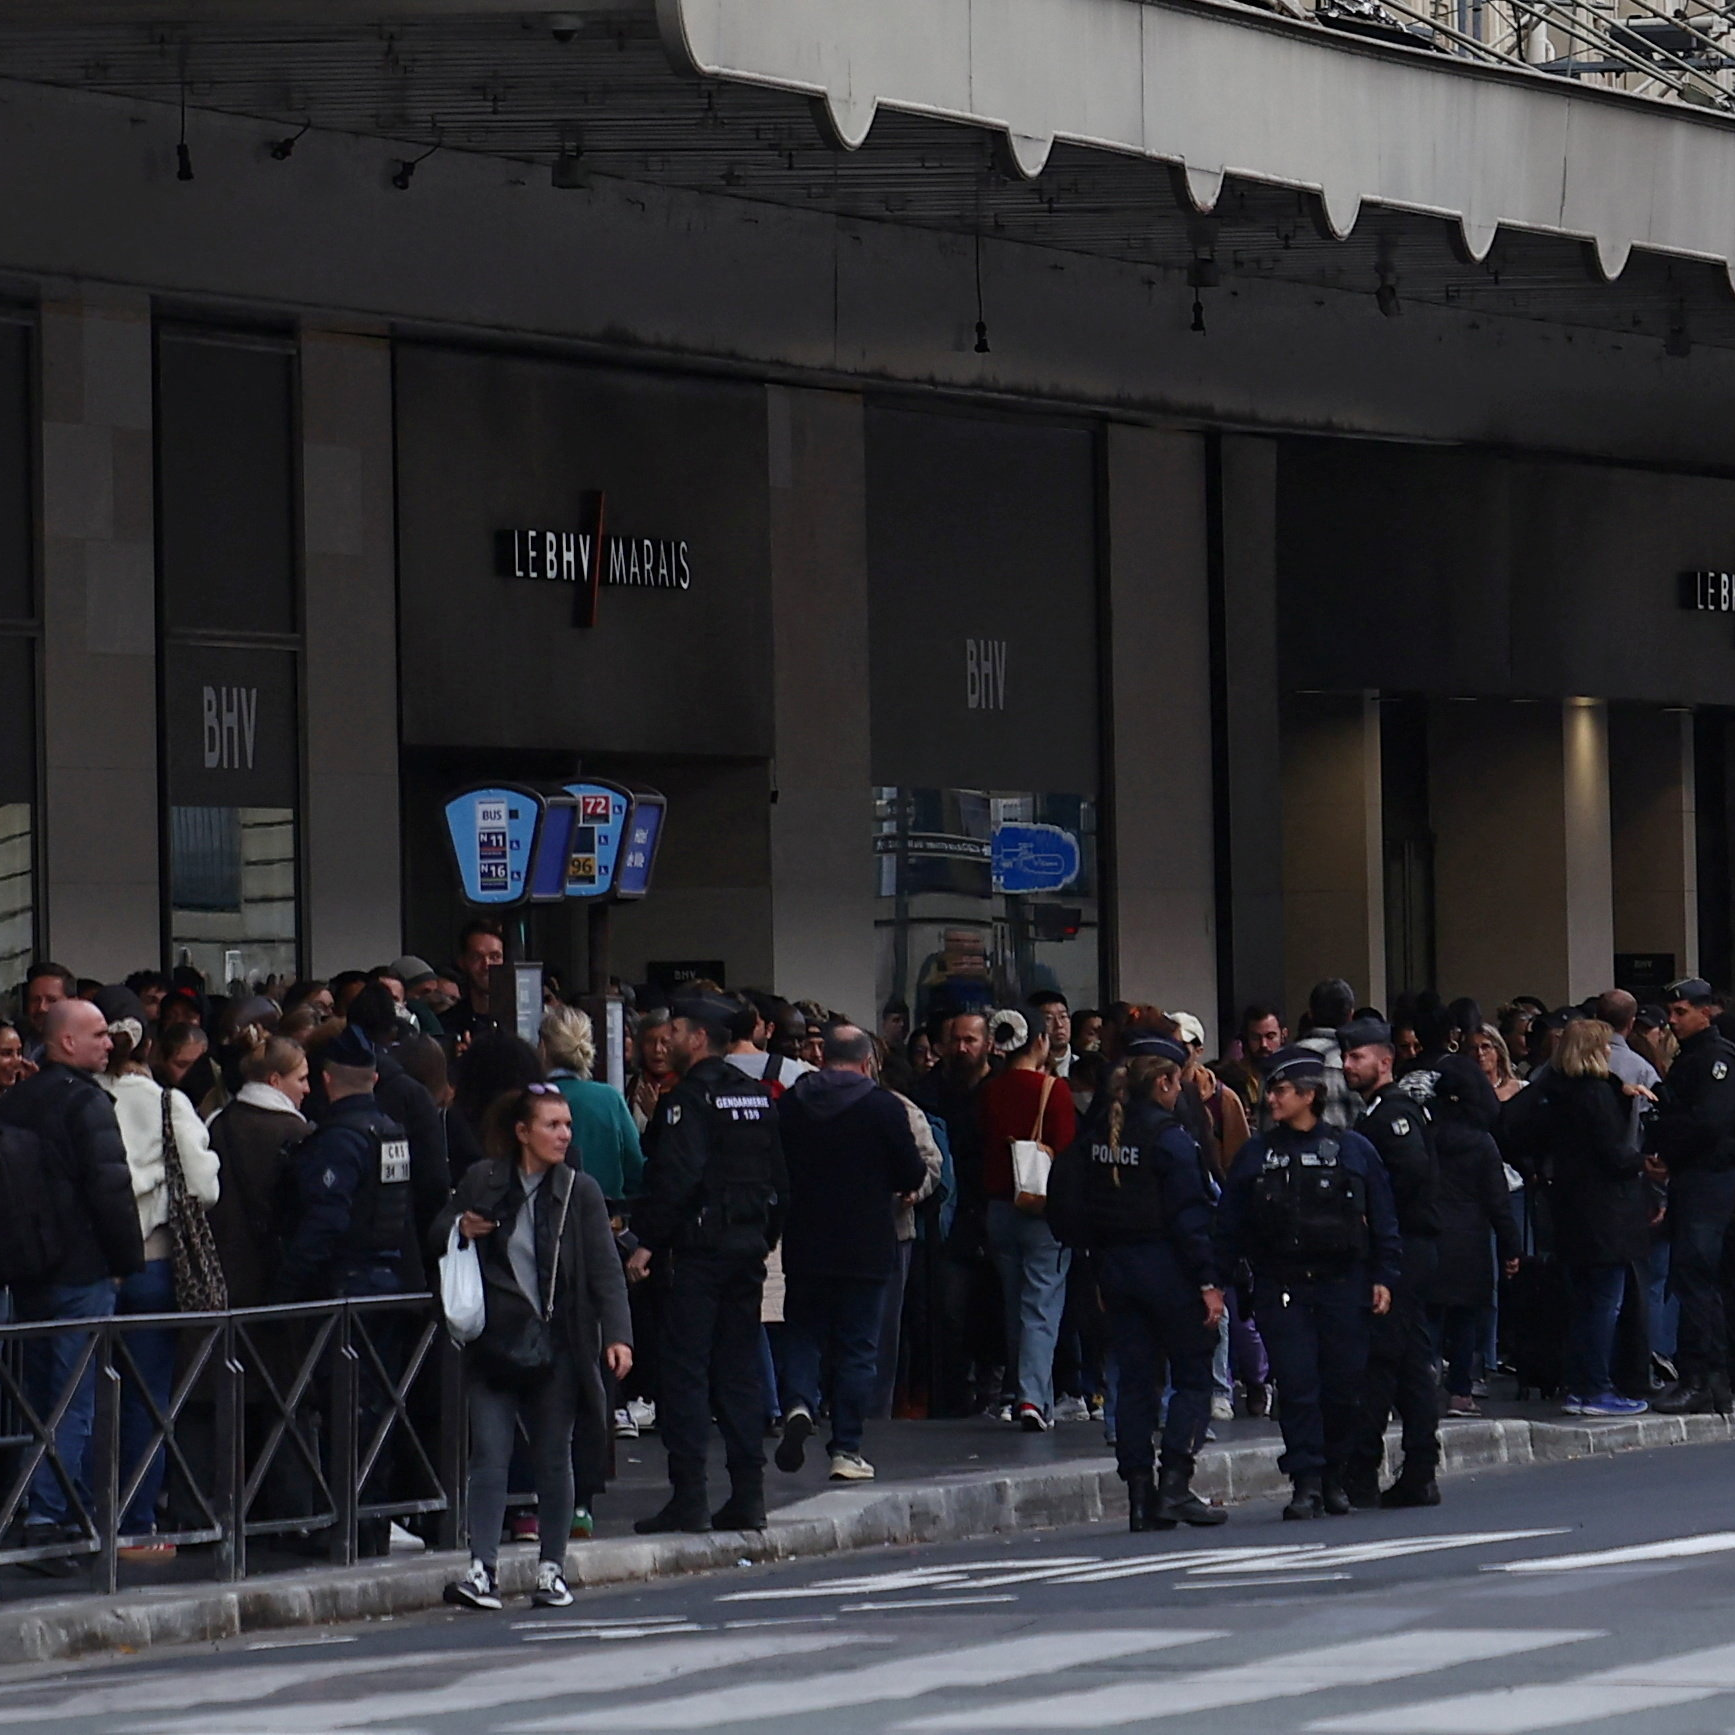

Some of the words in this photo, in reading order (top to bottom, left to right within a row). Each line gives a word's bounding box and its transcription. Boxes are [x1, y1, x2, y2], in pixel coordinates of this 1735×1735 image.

[514, 529, 538, 578] LE
[545, 531, 591, 583] BHV
[608, 535, 691, 590] MARAIS
[1697, 572, 1715, 610] LE
[966, 638, 1006, 710] BHV
[203, 685, 258, 770] BHV
[585, 798, 606, 814] 72
[482, 810, 502, 821] BUS
[571, 858, 593, 873] 96
[674, 970, 696, 980] BHV
[716, 1096, 769, 1109] GENDARMERIE
[388, 1145, 405, 1159] CRS
